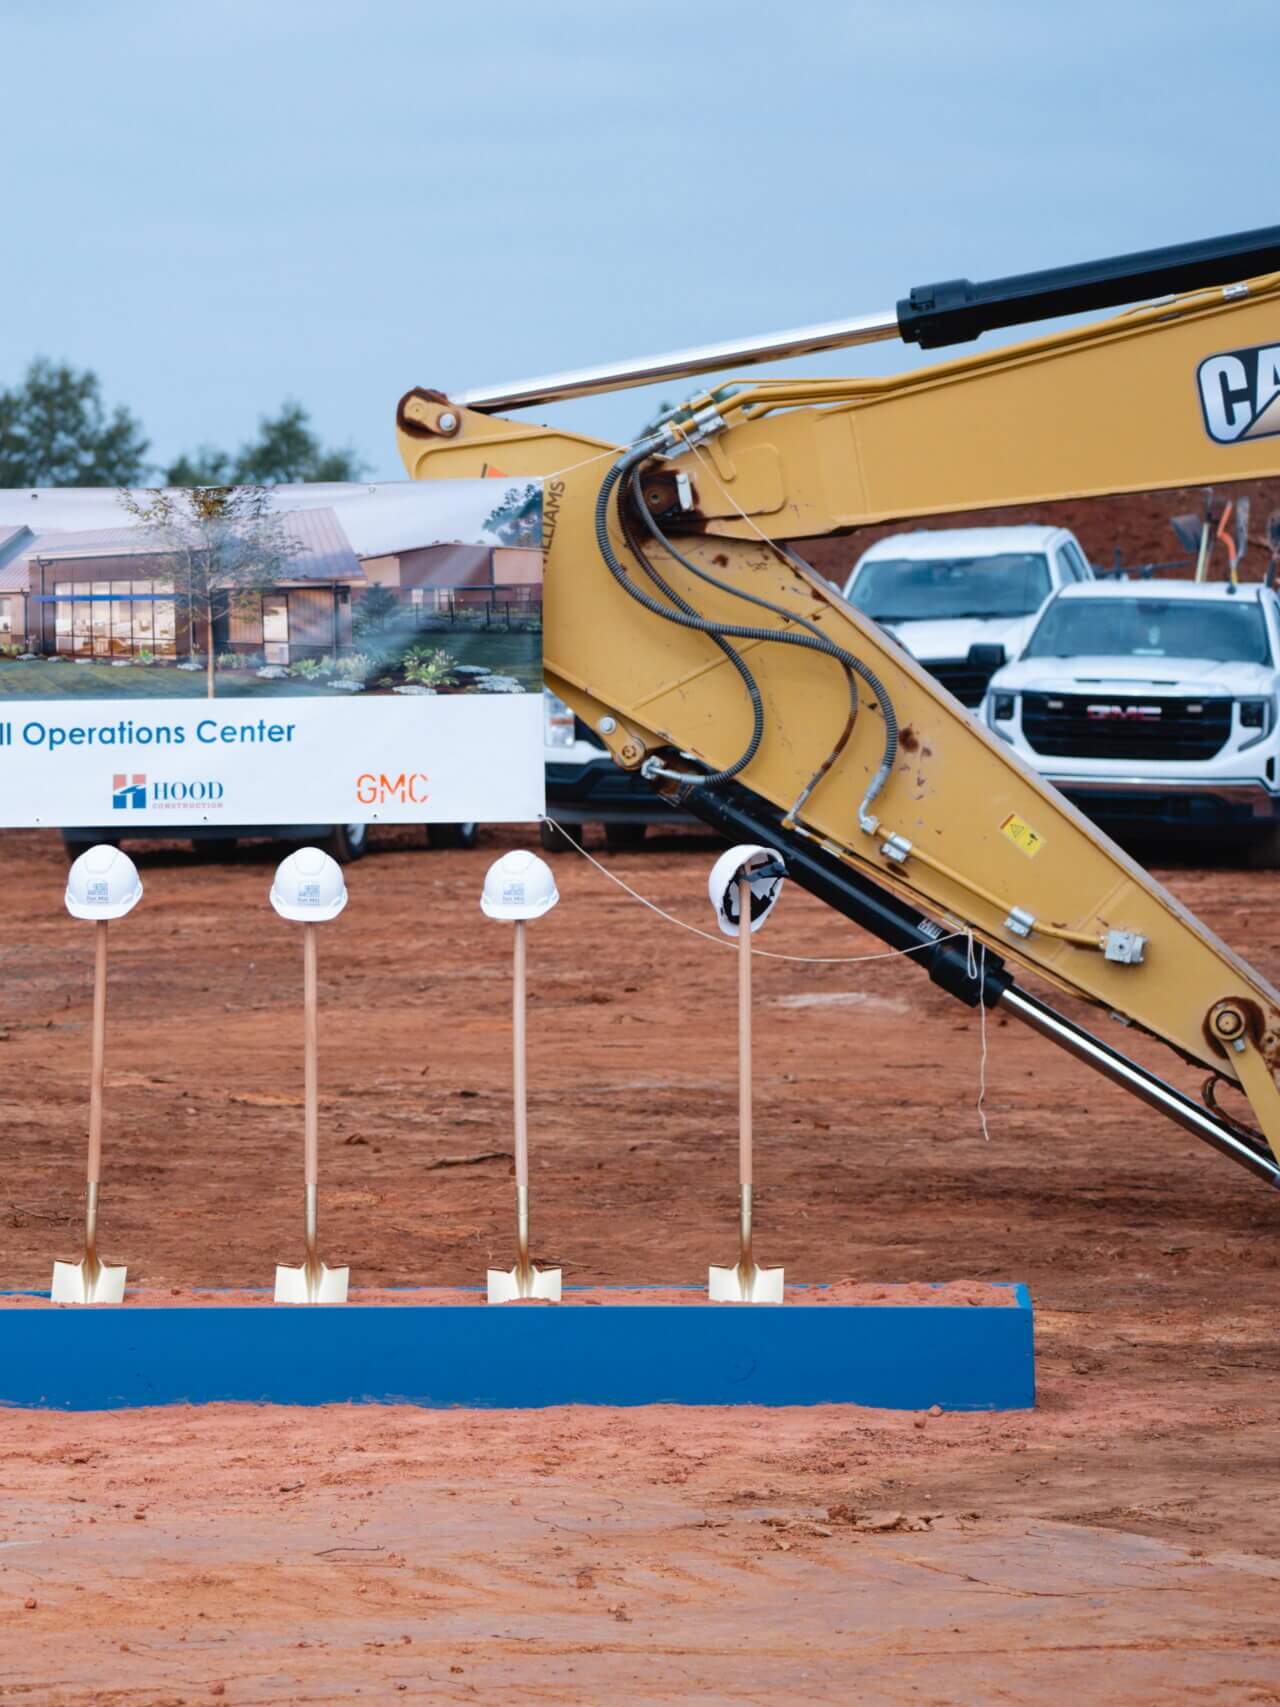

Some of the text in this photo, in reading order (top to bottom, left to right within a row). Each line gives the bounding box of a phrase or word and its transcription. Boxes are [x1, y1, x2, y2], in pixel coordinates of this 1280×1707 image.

[543, 481, 565, 573] LLIAMS
[23, 721, 185, 751] Operations
[196, 719, 296, 743] Center
[153, 781, 224, 800] HOOD
[357, 774, 429, 804] GMC
